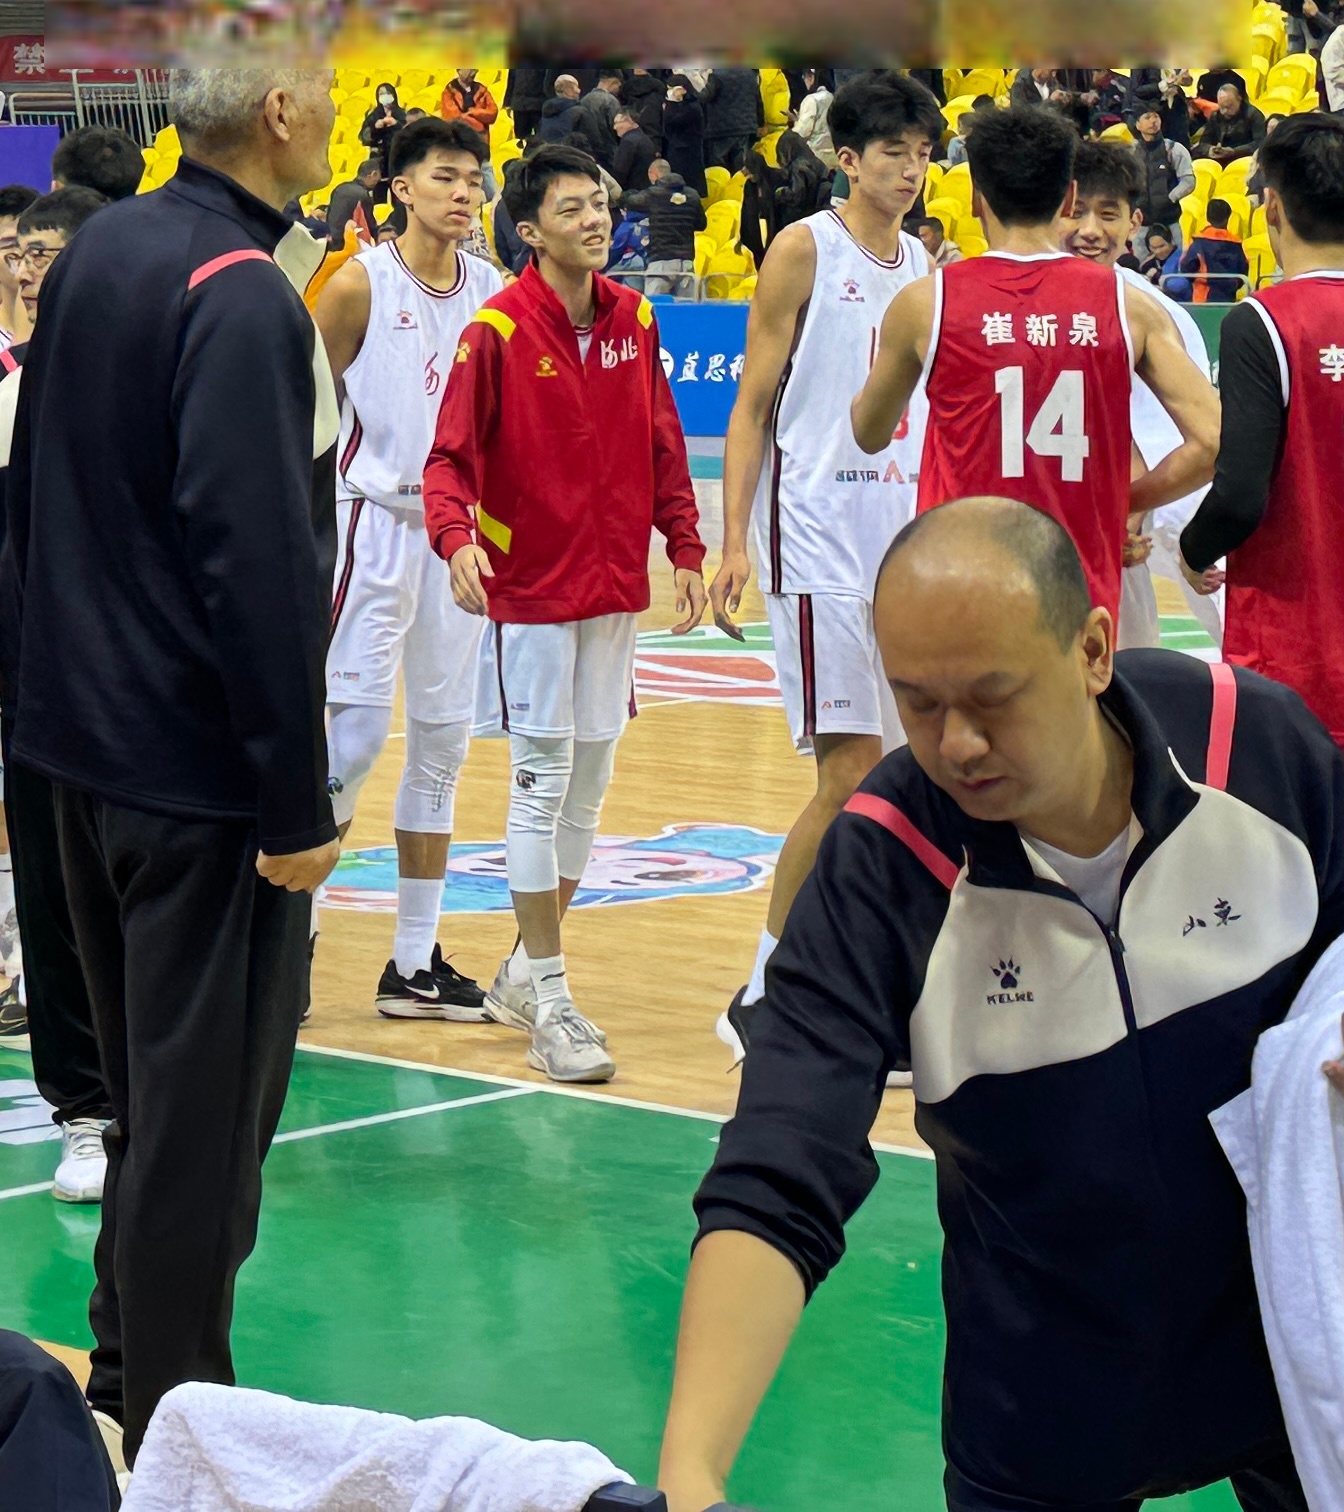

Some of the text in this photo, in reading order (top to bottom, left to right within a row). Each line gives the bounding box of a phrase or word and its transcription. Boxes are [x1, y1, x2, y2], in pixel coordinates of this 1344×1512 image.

[981, 311, 1100, 348] 崔新泉
[994, 365, 1090, 483] 14
